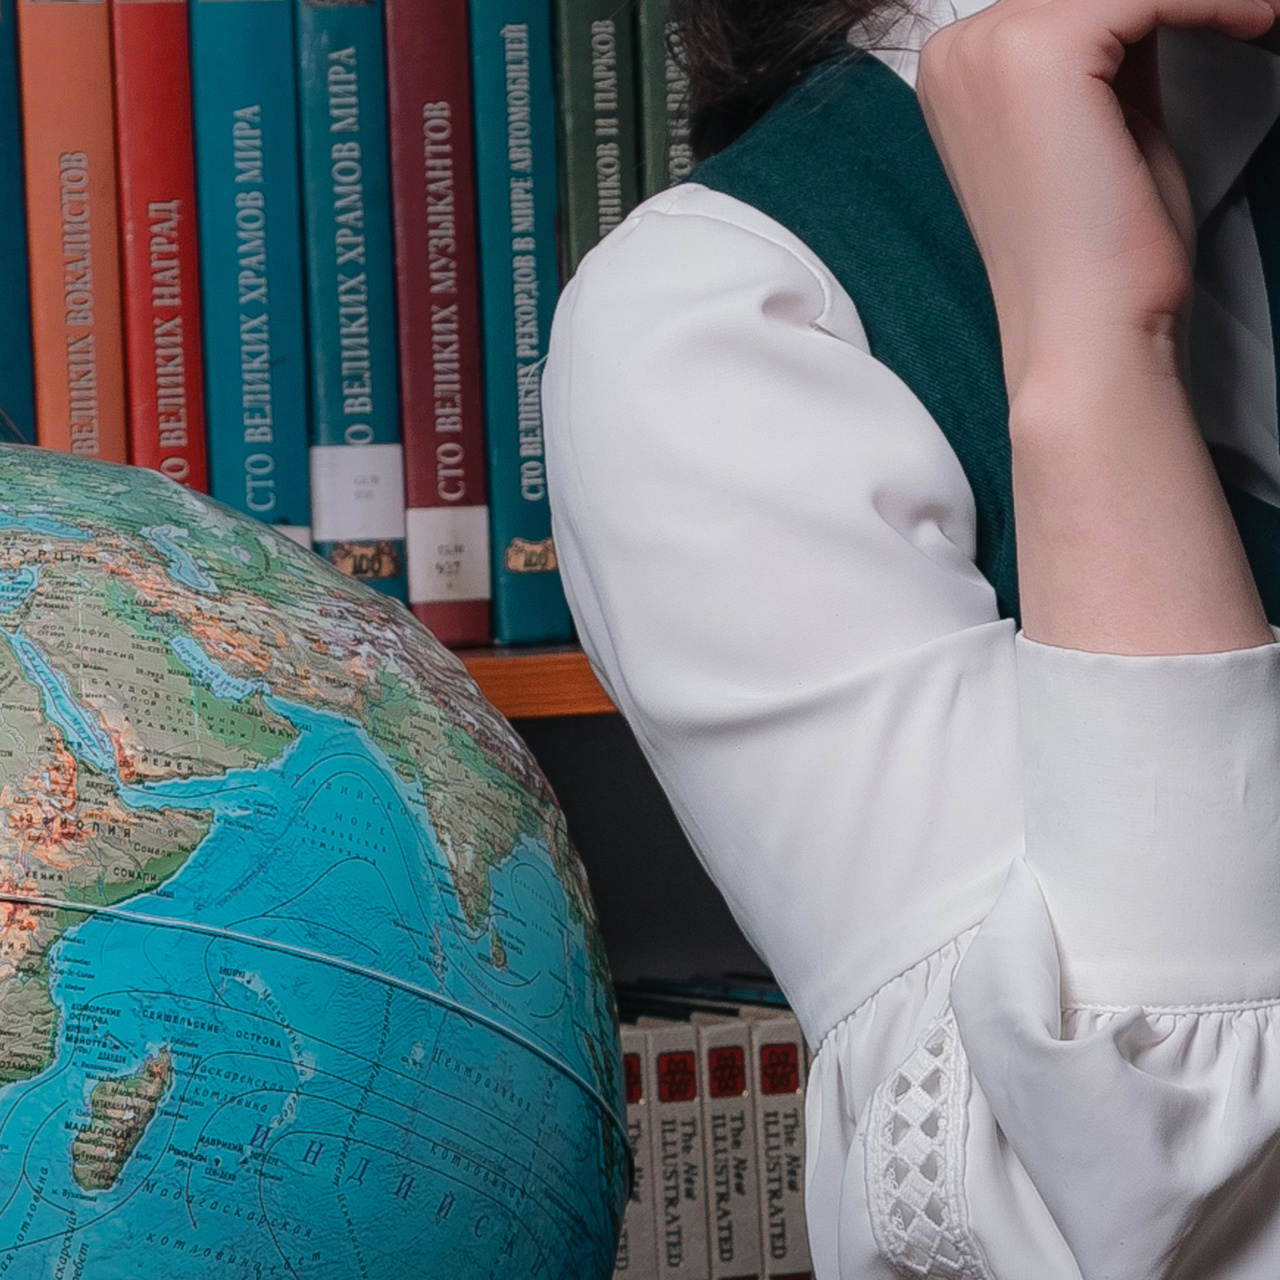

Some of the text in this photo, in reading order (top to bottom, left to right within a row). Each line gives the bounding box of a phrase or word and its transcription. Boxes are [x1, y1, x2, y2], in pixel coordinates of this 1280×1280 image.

[327, 46, 360, 134] МИРА
[591, 20, 620, 138] И ПАРКОВ
[330, 140, 367, 266] ХРАМОВ
[422, 100, 458, 295] МУЗЫКАНТОВ
[147, 199, 183, 309] НАГРАД
[500, 23, 546, 502] СТО ВЕЛИКИХ РЕКОРДОВ В МИРЕ АВТОМОБИЛЕЙ
[59, 150, 99, 456] ВЕЛИКИХ ВОКАЛИСТОВ
[233, 103, 277, 512] СТО ВЕЛИКИХ ХРАМОВ МИРА
[338, 272, 374, 415] ВЕЛИКИХ
[430, 304, 464, 433] ВЕЛИКИХ
[154, 316, 189, 448] ВЕЛИКИХ
[436, 441, 467, 503] СТО
[5, 546, 98, 565] ТУРЦИЯ
[141, 754, 195, 772] ЙЕМЕН
[259, 724, 295, 740] ОМАН
[26, 812, 132, 839] ЭФИОПИЯ
[334, 811, 387, 837] МОРЕ
[113, 866, 158, 883] СОМАЛИ
[64, 1032, 108, 1050] Майотта
[69, 1012, 109, 1026] ОСТРОВА
[70, 1002, 122, 1018] КОМОРСКИЕ
[141, 1008, 283, 1050] СЕЙШЕЛЬСКИЕ ОСТРОВА
[680, 1116, 697, 1155] The
[730, 1110, 746, 1150] The
[783, 1108, 800, 1147] The
[660, 1120, 683, 1269] ILLUSTRATED
[711, 1113, 735, 1263] ILLUSTRATED
[762, 1109, 788, 1260] ILLUSTRATED
